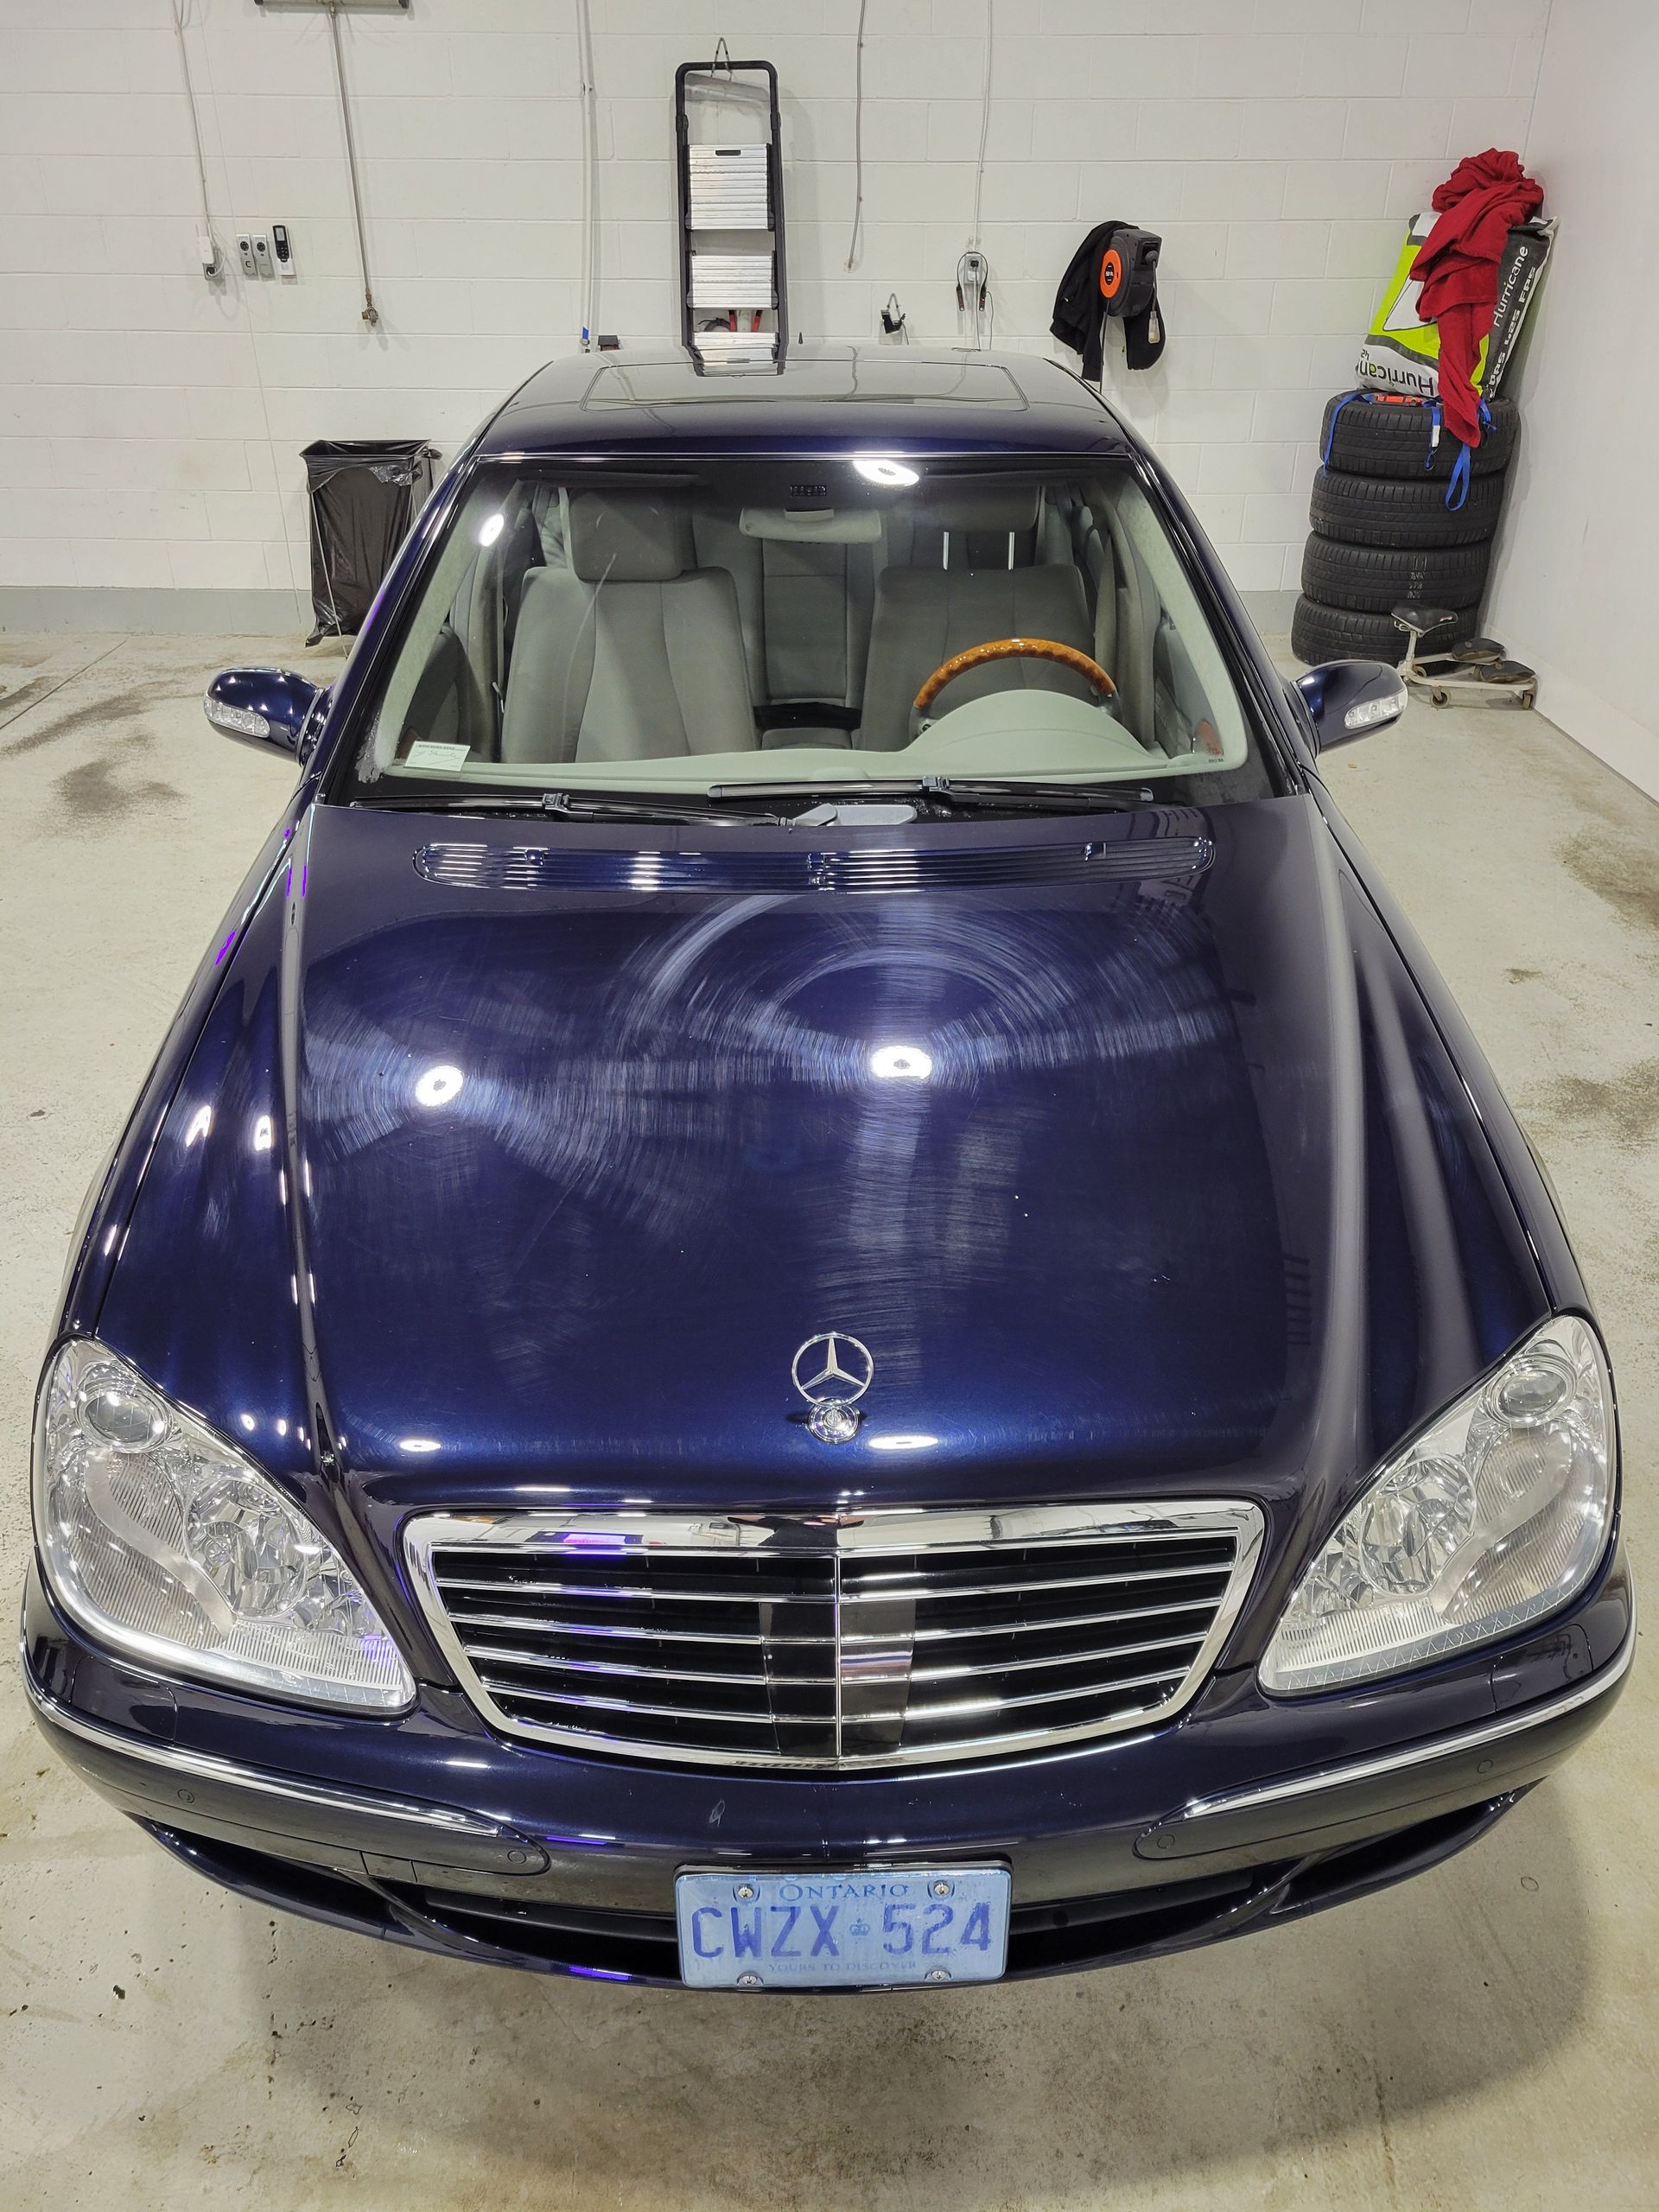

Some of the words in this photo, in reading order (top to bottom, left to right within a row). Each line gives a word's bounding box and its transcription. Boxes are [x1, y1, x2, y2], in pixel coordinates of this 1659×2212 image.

[1493, 246, 1529, 327] Hurricane
[1355, 359, 1434, 396] Hurrican
[779, 1883, 910, 1902] ONTARIO
[691, 1905, 840, 1959] CWZX
[882, 1902, 992, 1956] 524
[768, 1962, 816, 1972] YOURS
[823, 1962, 839, 1972] TO
[846, 1961, 917, 1972] DISCOVER
